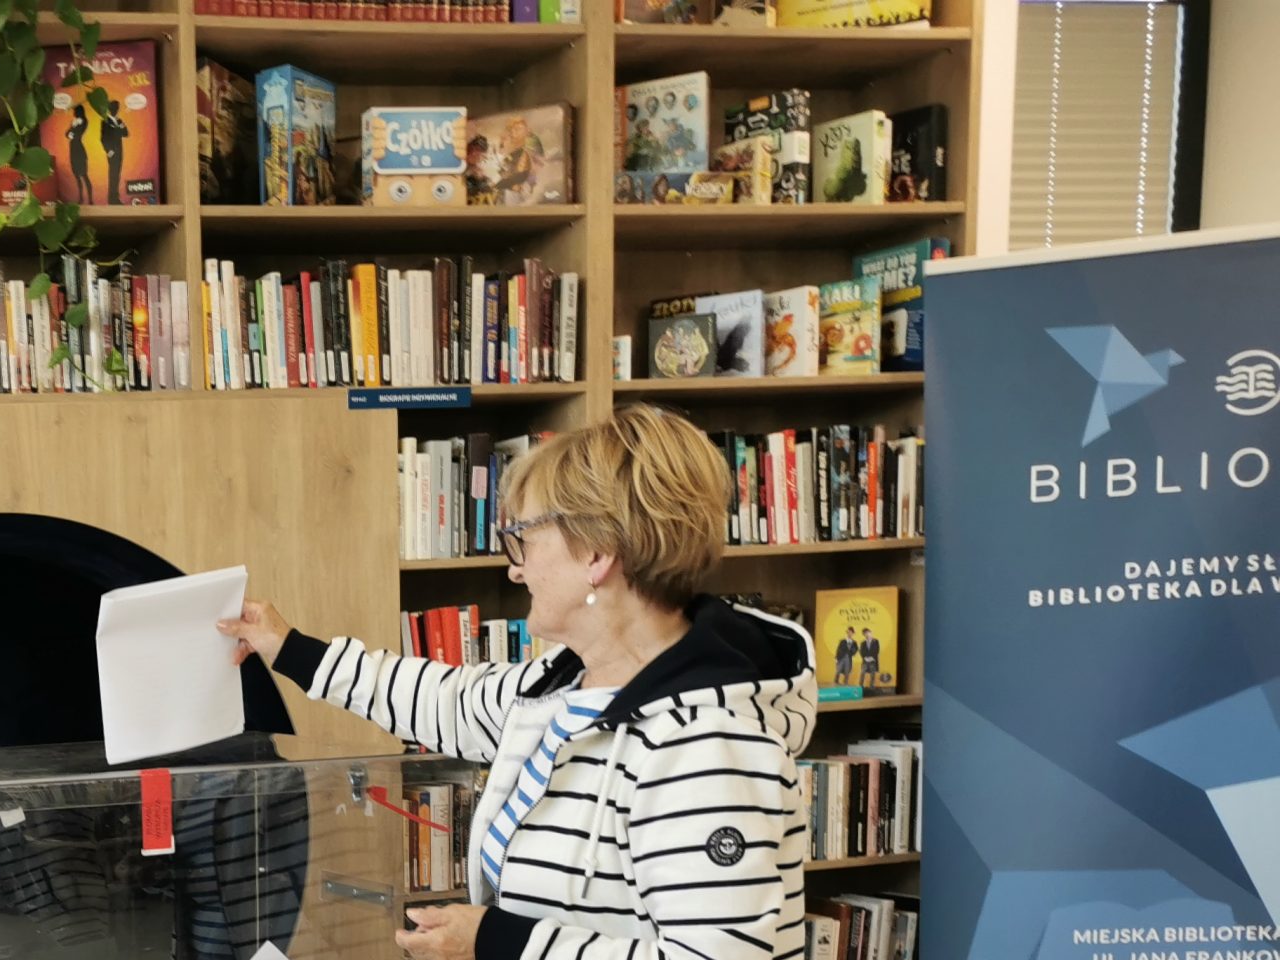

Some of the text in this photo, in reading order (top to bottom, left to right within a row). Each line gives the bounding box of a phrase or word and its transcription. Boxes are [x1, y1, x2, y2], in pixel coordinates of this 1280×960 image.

[385, 117, 453, 155] Czółko
[1030, 447, 1269, 503] BIBLIO
[1125, 555, 1239, 580] DAJEMY
[1028, 580, 1202, 607] BIBLIOTEKA
[1210, 577, 1263, 597] DLA
[1073, 927, 1160, 945] MIEJSKA
